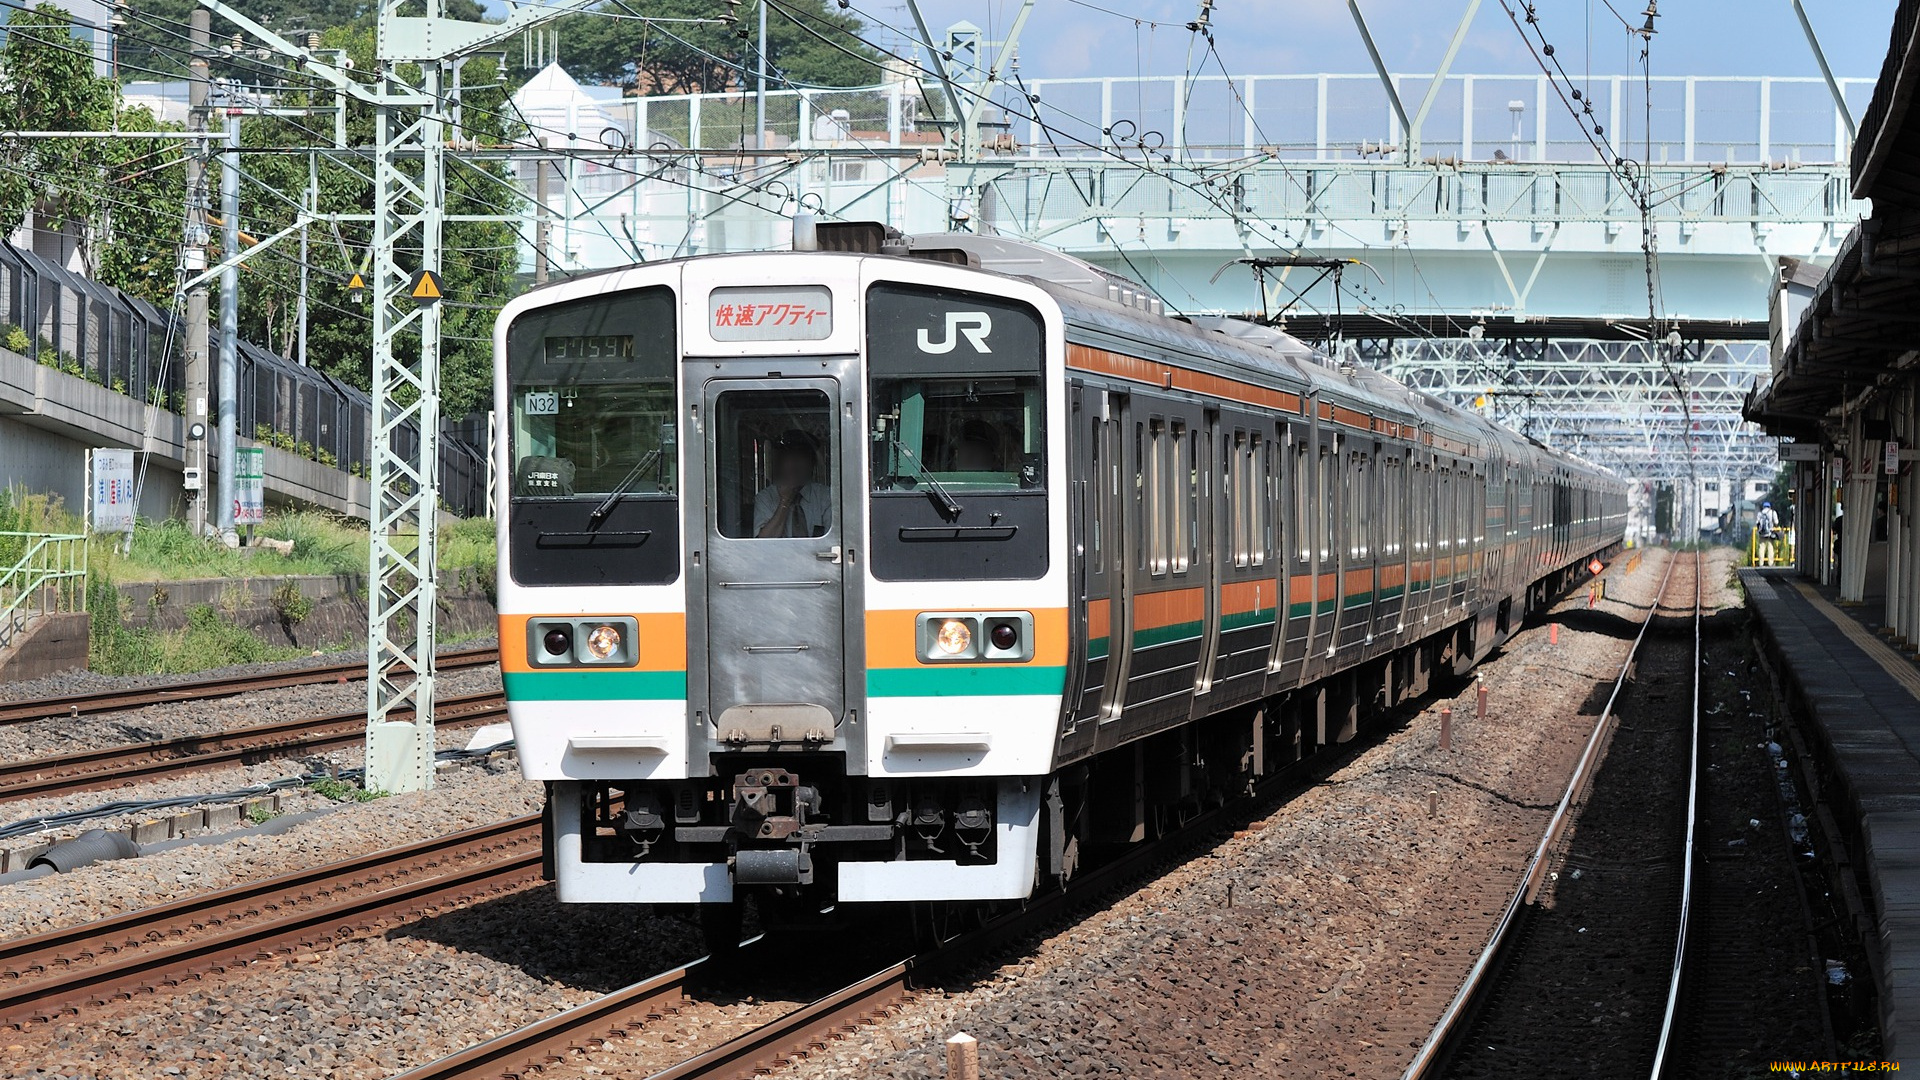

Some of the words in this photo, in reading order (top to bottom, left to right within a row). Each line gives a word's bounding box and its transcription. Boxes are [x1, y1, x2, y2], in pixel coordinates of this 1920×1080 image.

[715, 304, 827, 326] 快速アクティー
[917, 312, 992, 354] JR
[529, 397, 555, 412] N32
[527, 471, 559, 480] JR東日本
